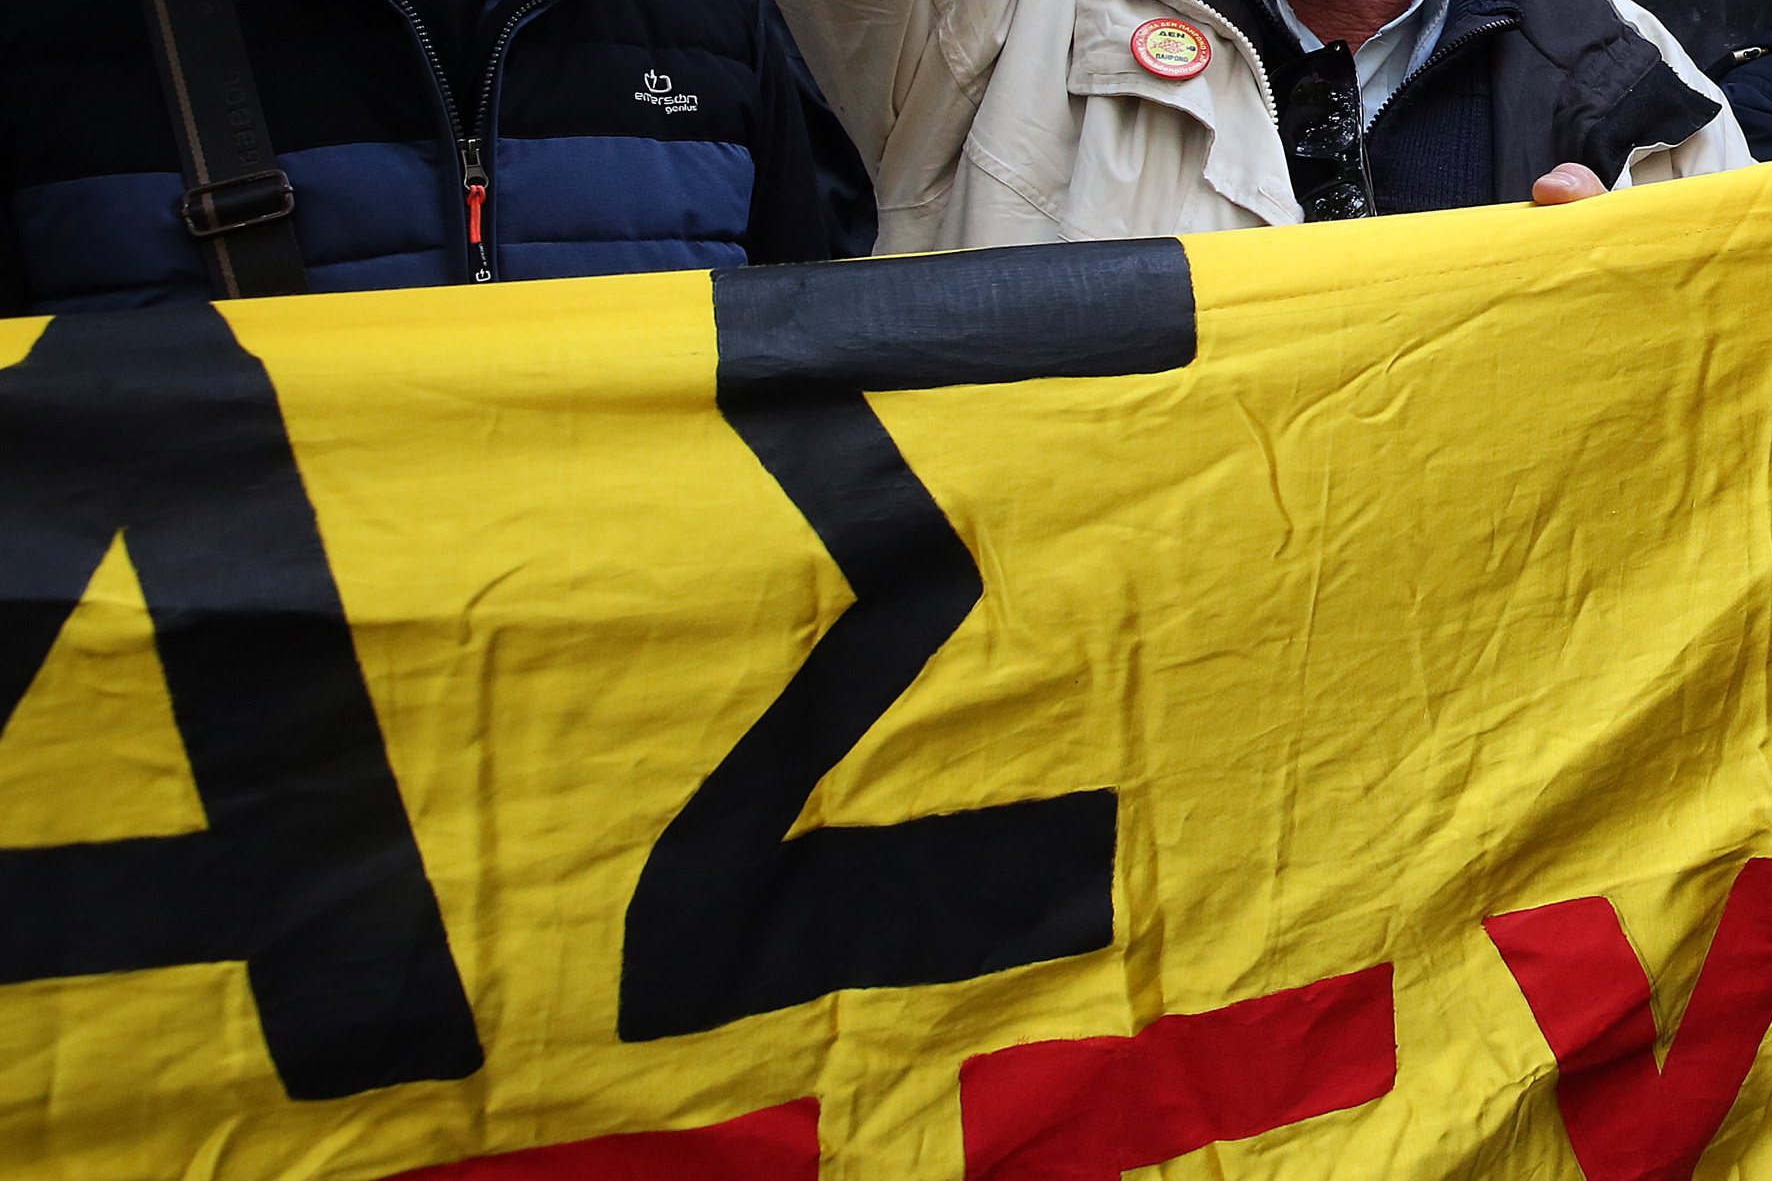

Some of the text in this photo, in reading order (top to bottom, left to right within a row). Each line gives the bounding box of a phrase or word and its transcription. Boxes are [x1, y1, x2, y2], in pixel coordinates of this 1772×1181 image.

[1159, 31, 1185, 39] ΔΕΝ
[1155, 53, 1189, 63] ΠΛΗΡΩΝΩ
[634, 91, 698, 106] emerson
[665, 104, 698, 115] genius
